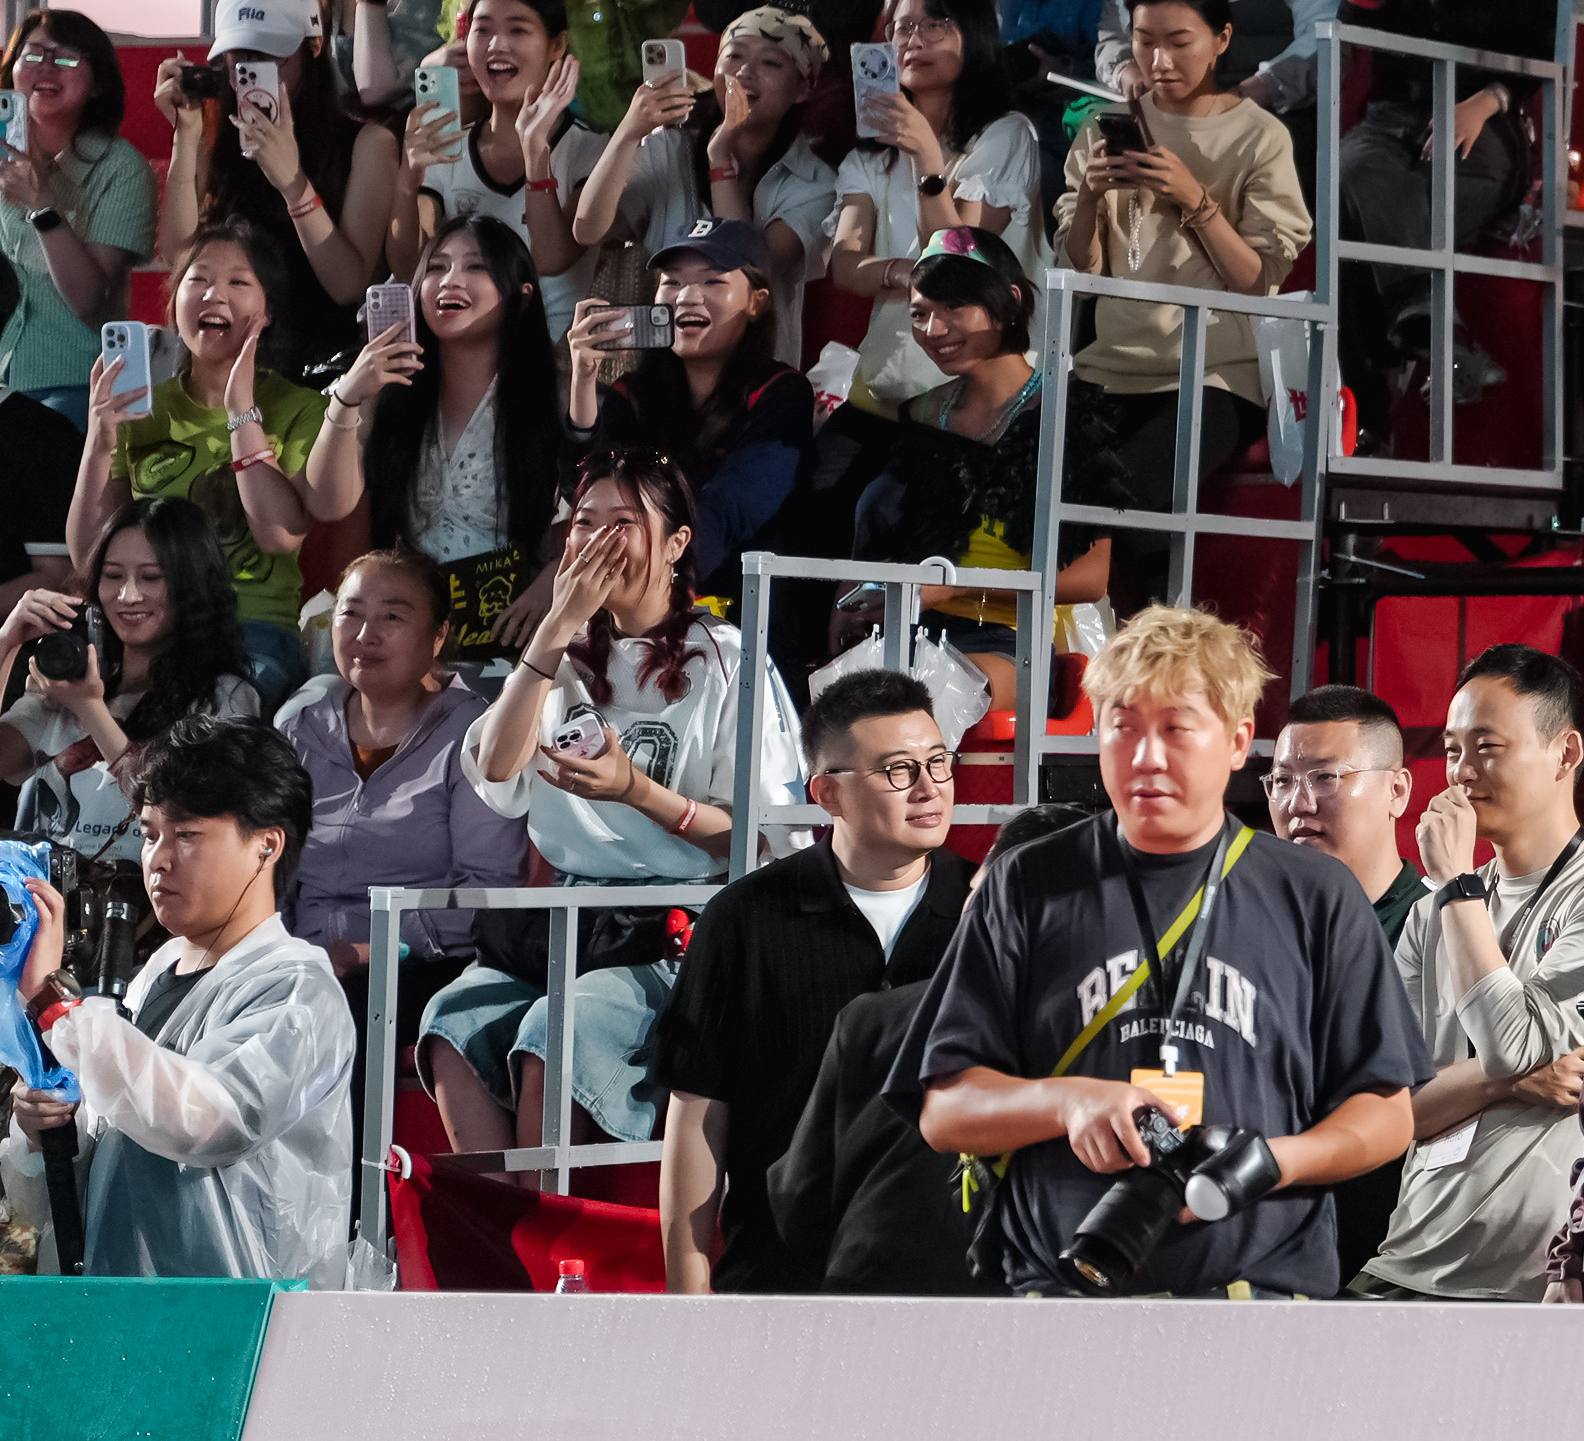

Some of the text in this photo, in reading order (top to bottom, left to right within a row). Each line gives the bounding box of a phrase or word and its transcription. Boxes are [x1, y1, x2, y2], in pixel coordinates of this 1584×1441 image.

[238, 6, 265, 22] Fila
[475, 557, 511, 574] MIKA
[1076, 950, 1258, 1050] BEIN
